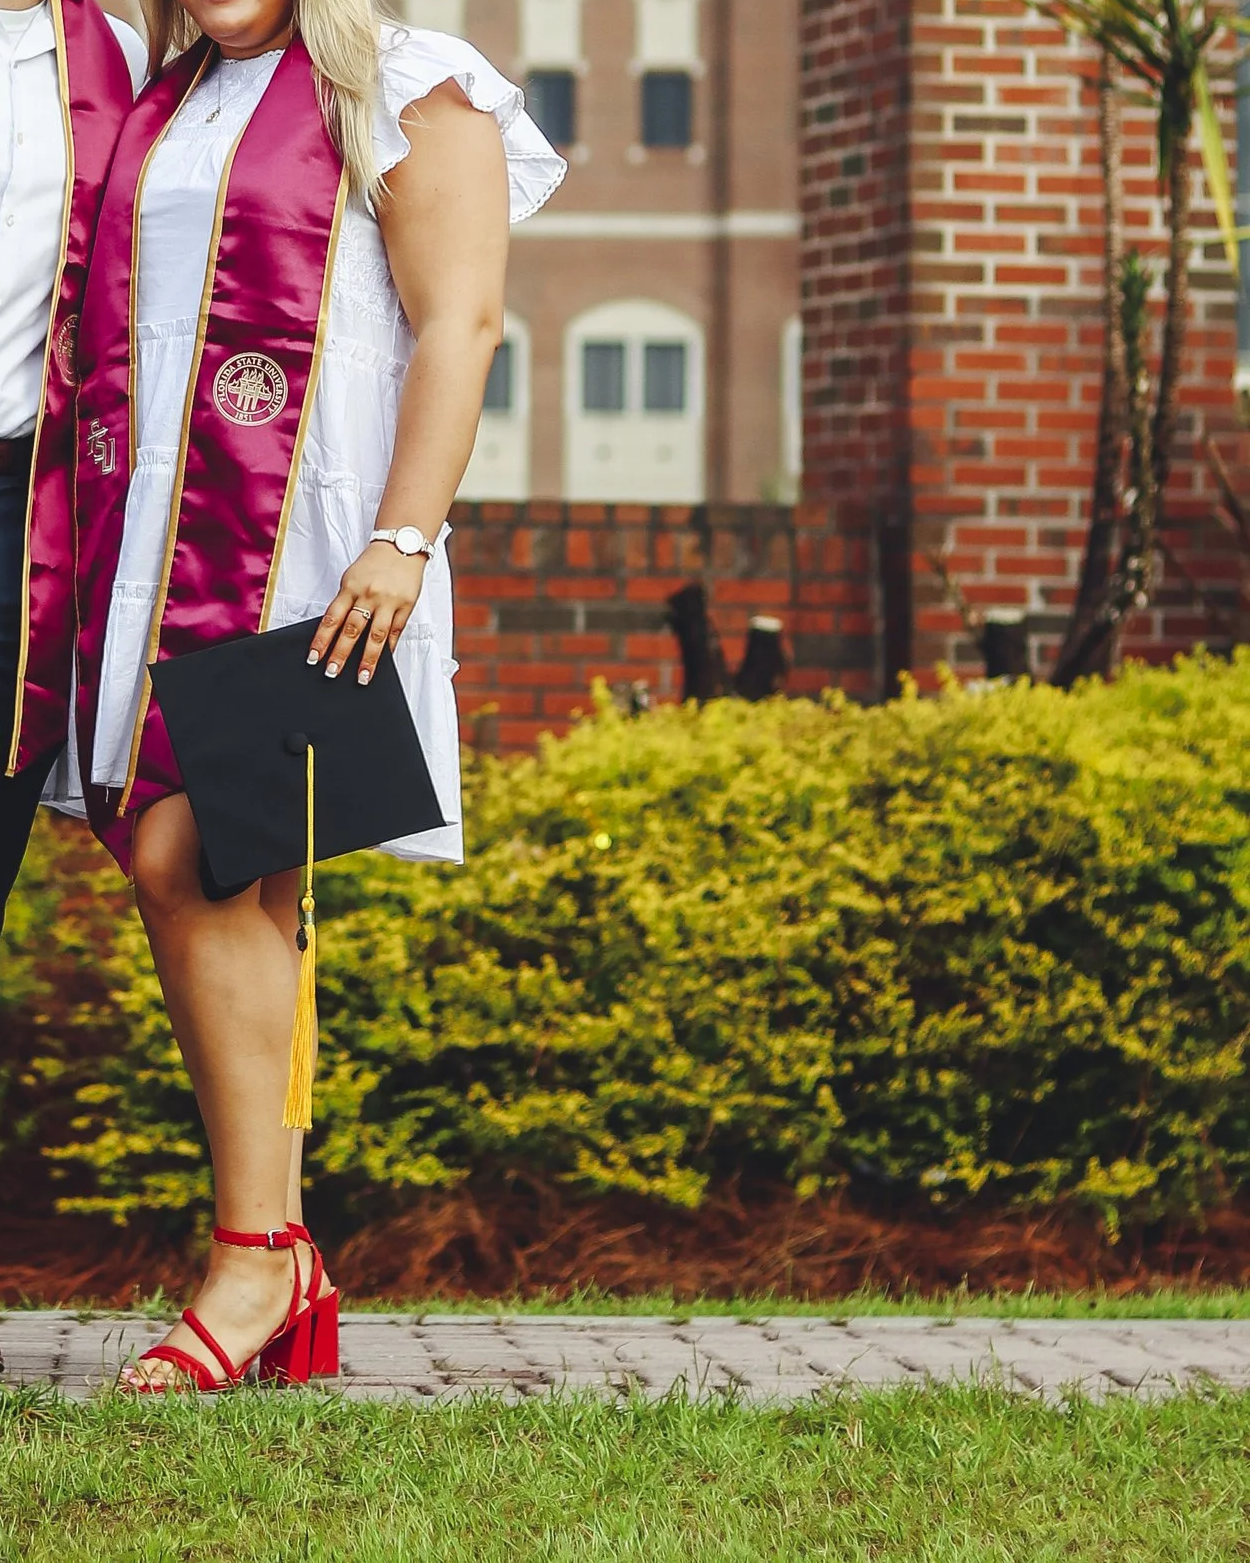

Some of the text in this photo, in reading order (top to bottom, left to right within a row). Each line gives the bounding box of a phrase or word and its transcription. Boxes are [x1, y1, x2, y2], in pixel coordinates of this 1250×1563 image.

[218, 357, 283, 414] FLORIDA STATE UNIVERSITY
[235, 412, 253, 422] 1851
